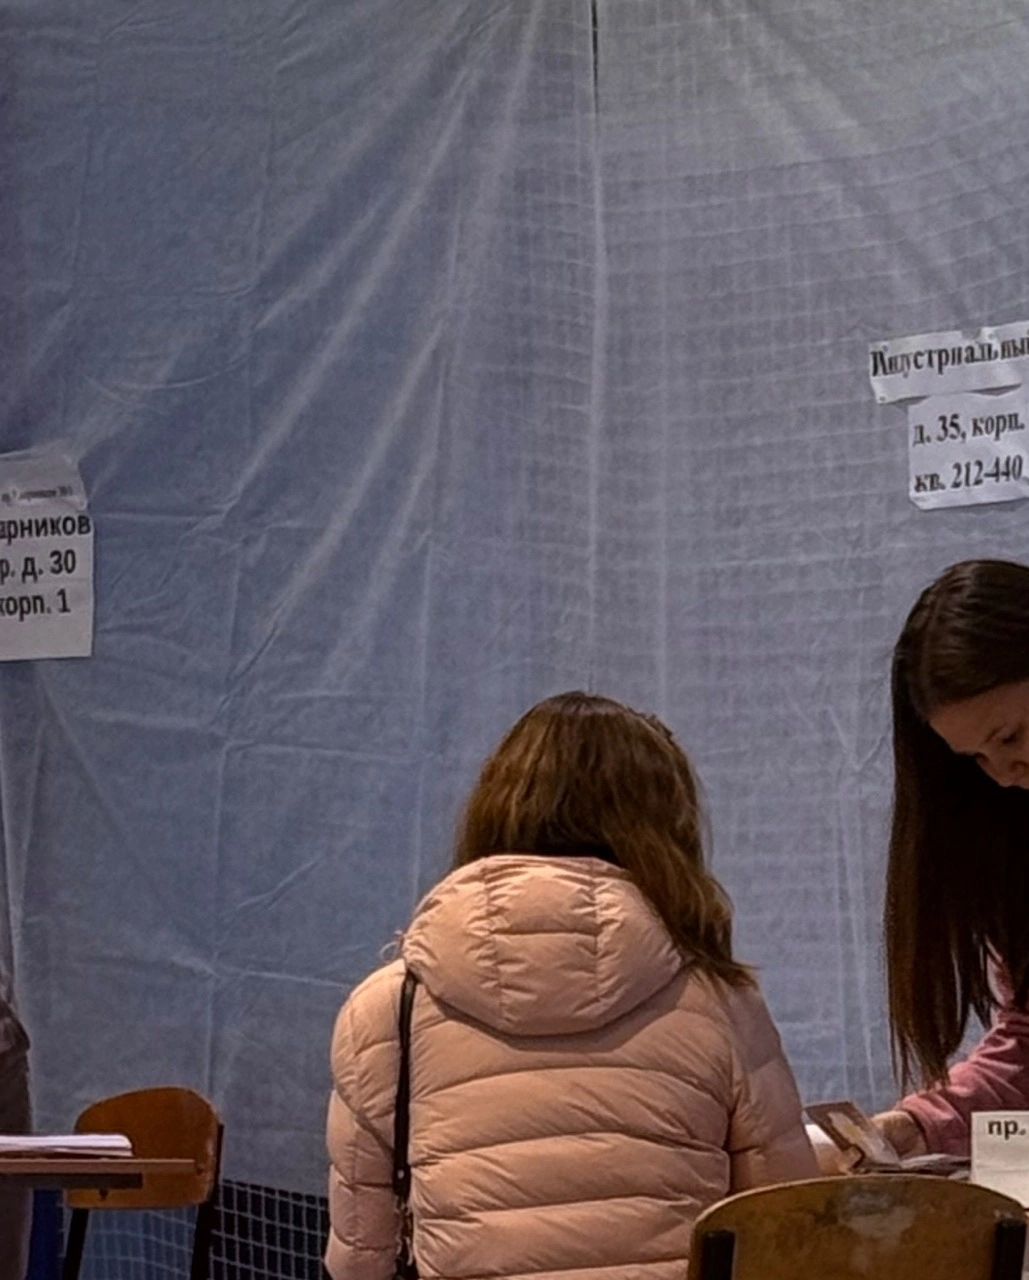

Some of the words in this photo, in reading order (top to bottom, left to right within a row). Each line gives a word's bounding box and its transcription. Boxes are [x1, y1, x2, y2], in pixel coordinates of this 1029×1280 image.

[937, 413, 967, 443] 35,
[972, 412, 1024, 441] корп.
[914, 474, 945, 493] кв.
[951, 454, 1023, 489] 212-440
[22, 556, 43, 584] д.
[50, 549, 76, 575] 30
[57, 588, 71, 614] 1
[987, 1118, 1026, 1140] пр.
